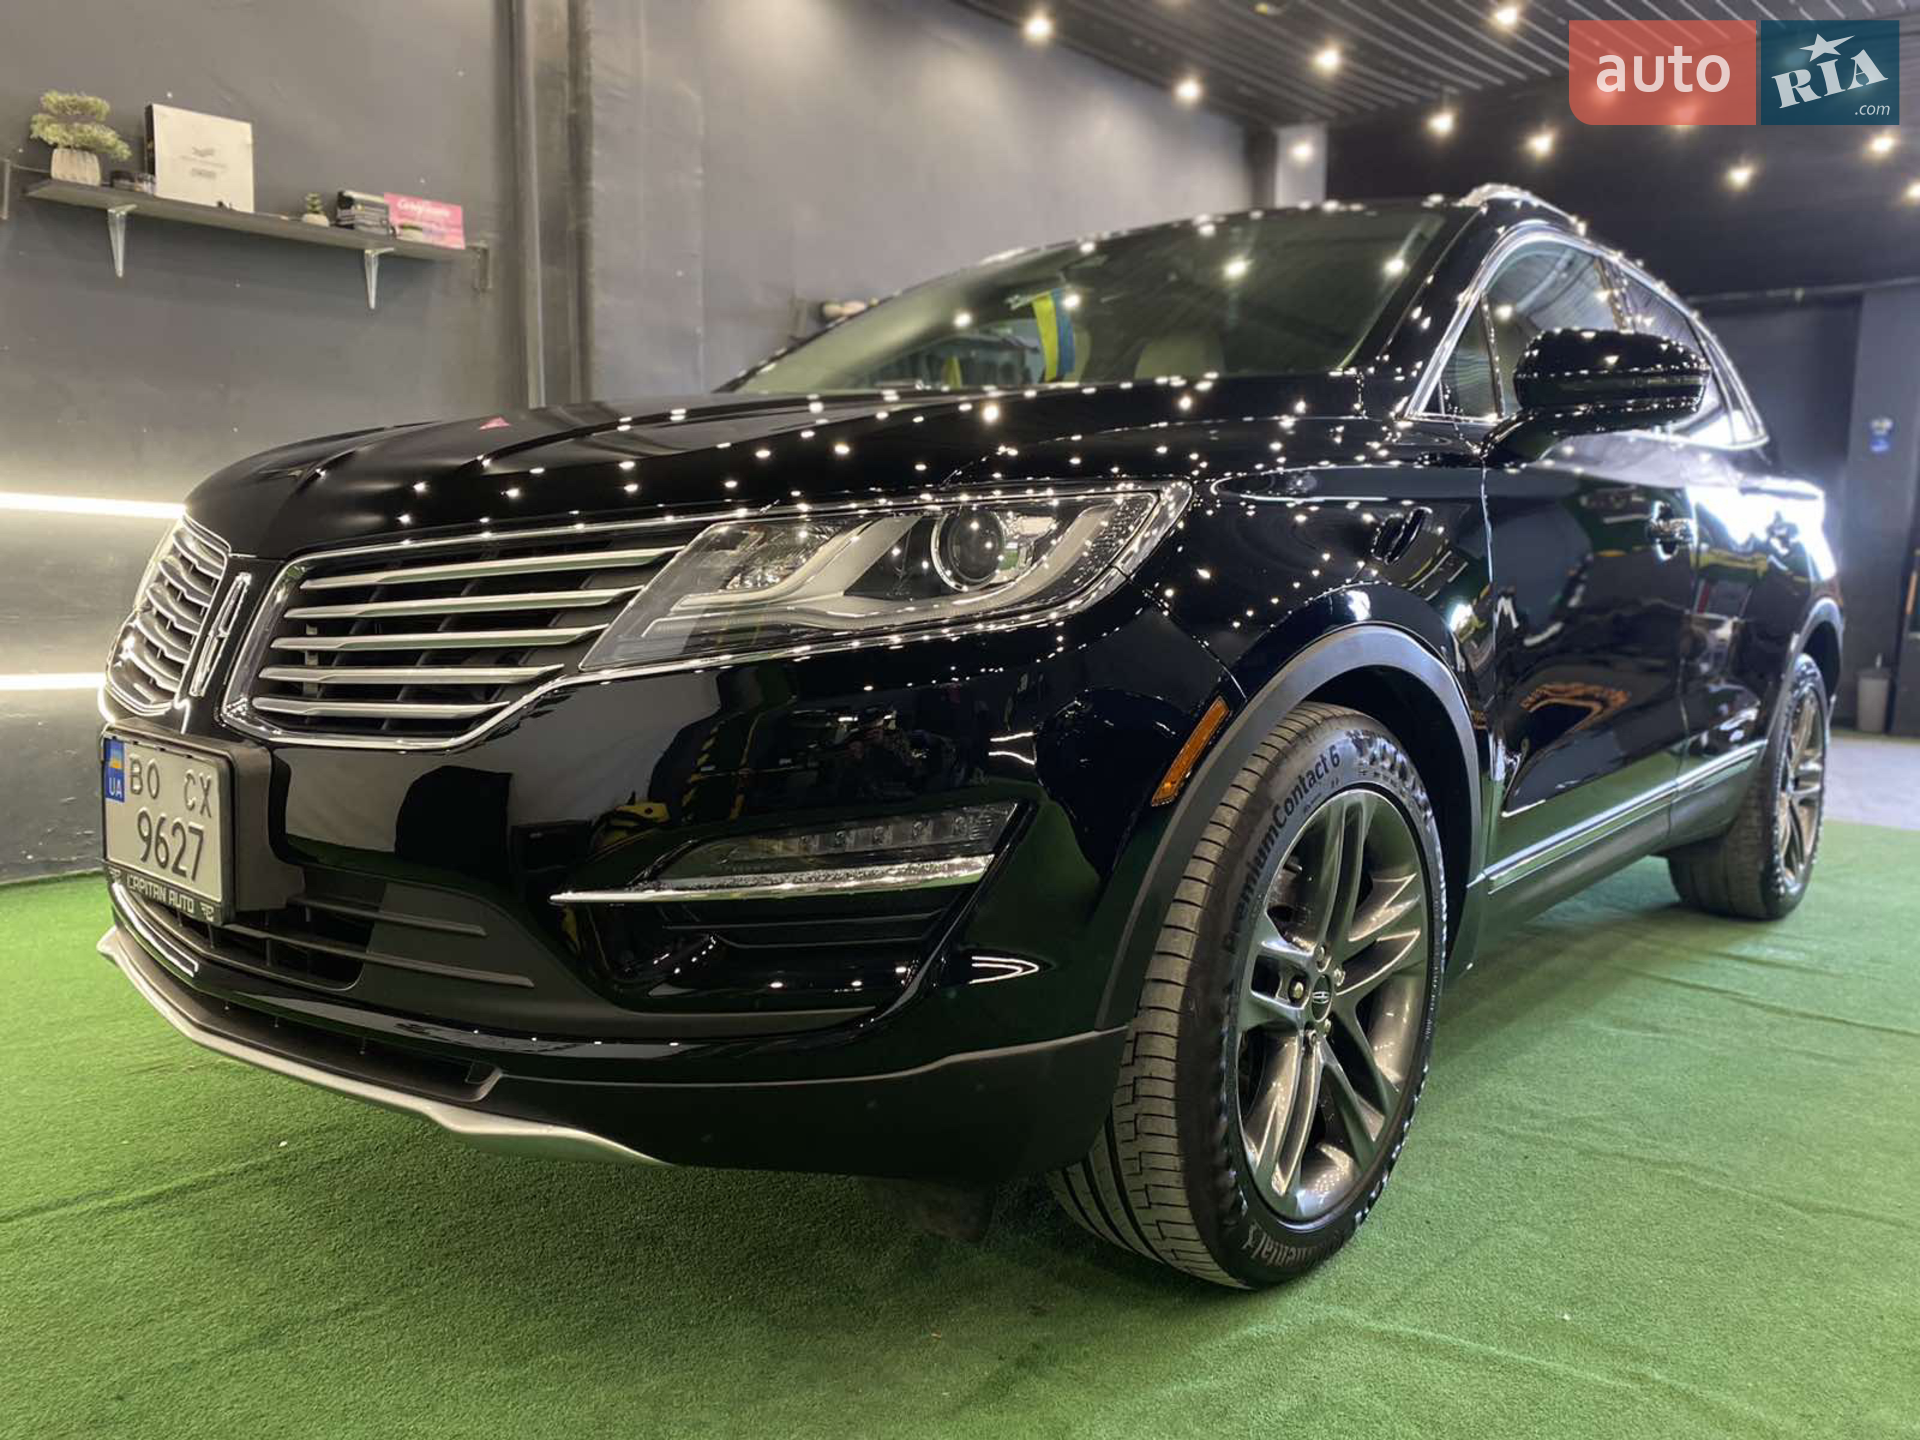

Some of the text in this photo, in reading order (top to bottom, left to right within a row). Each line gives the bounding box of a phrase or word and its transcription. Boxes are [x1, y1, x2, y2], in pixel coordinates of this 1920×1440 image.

[1331, 744, 1341, 769] 6
[109, 777, 123, 798] UA
[130, 753, 212, 819] BO CX
[137, 806, 205, 883] 9627
[126, 873, 194, 914] CAPITAN AUTO
